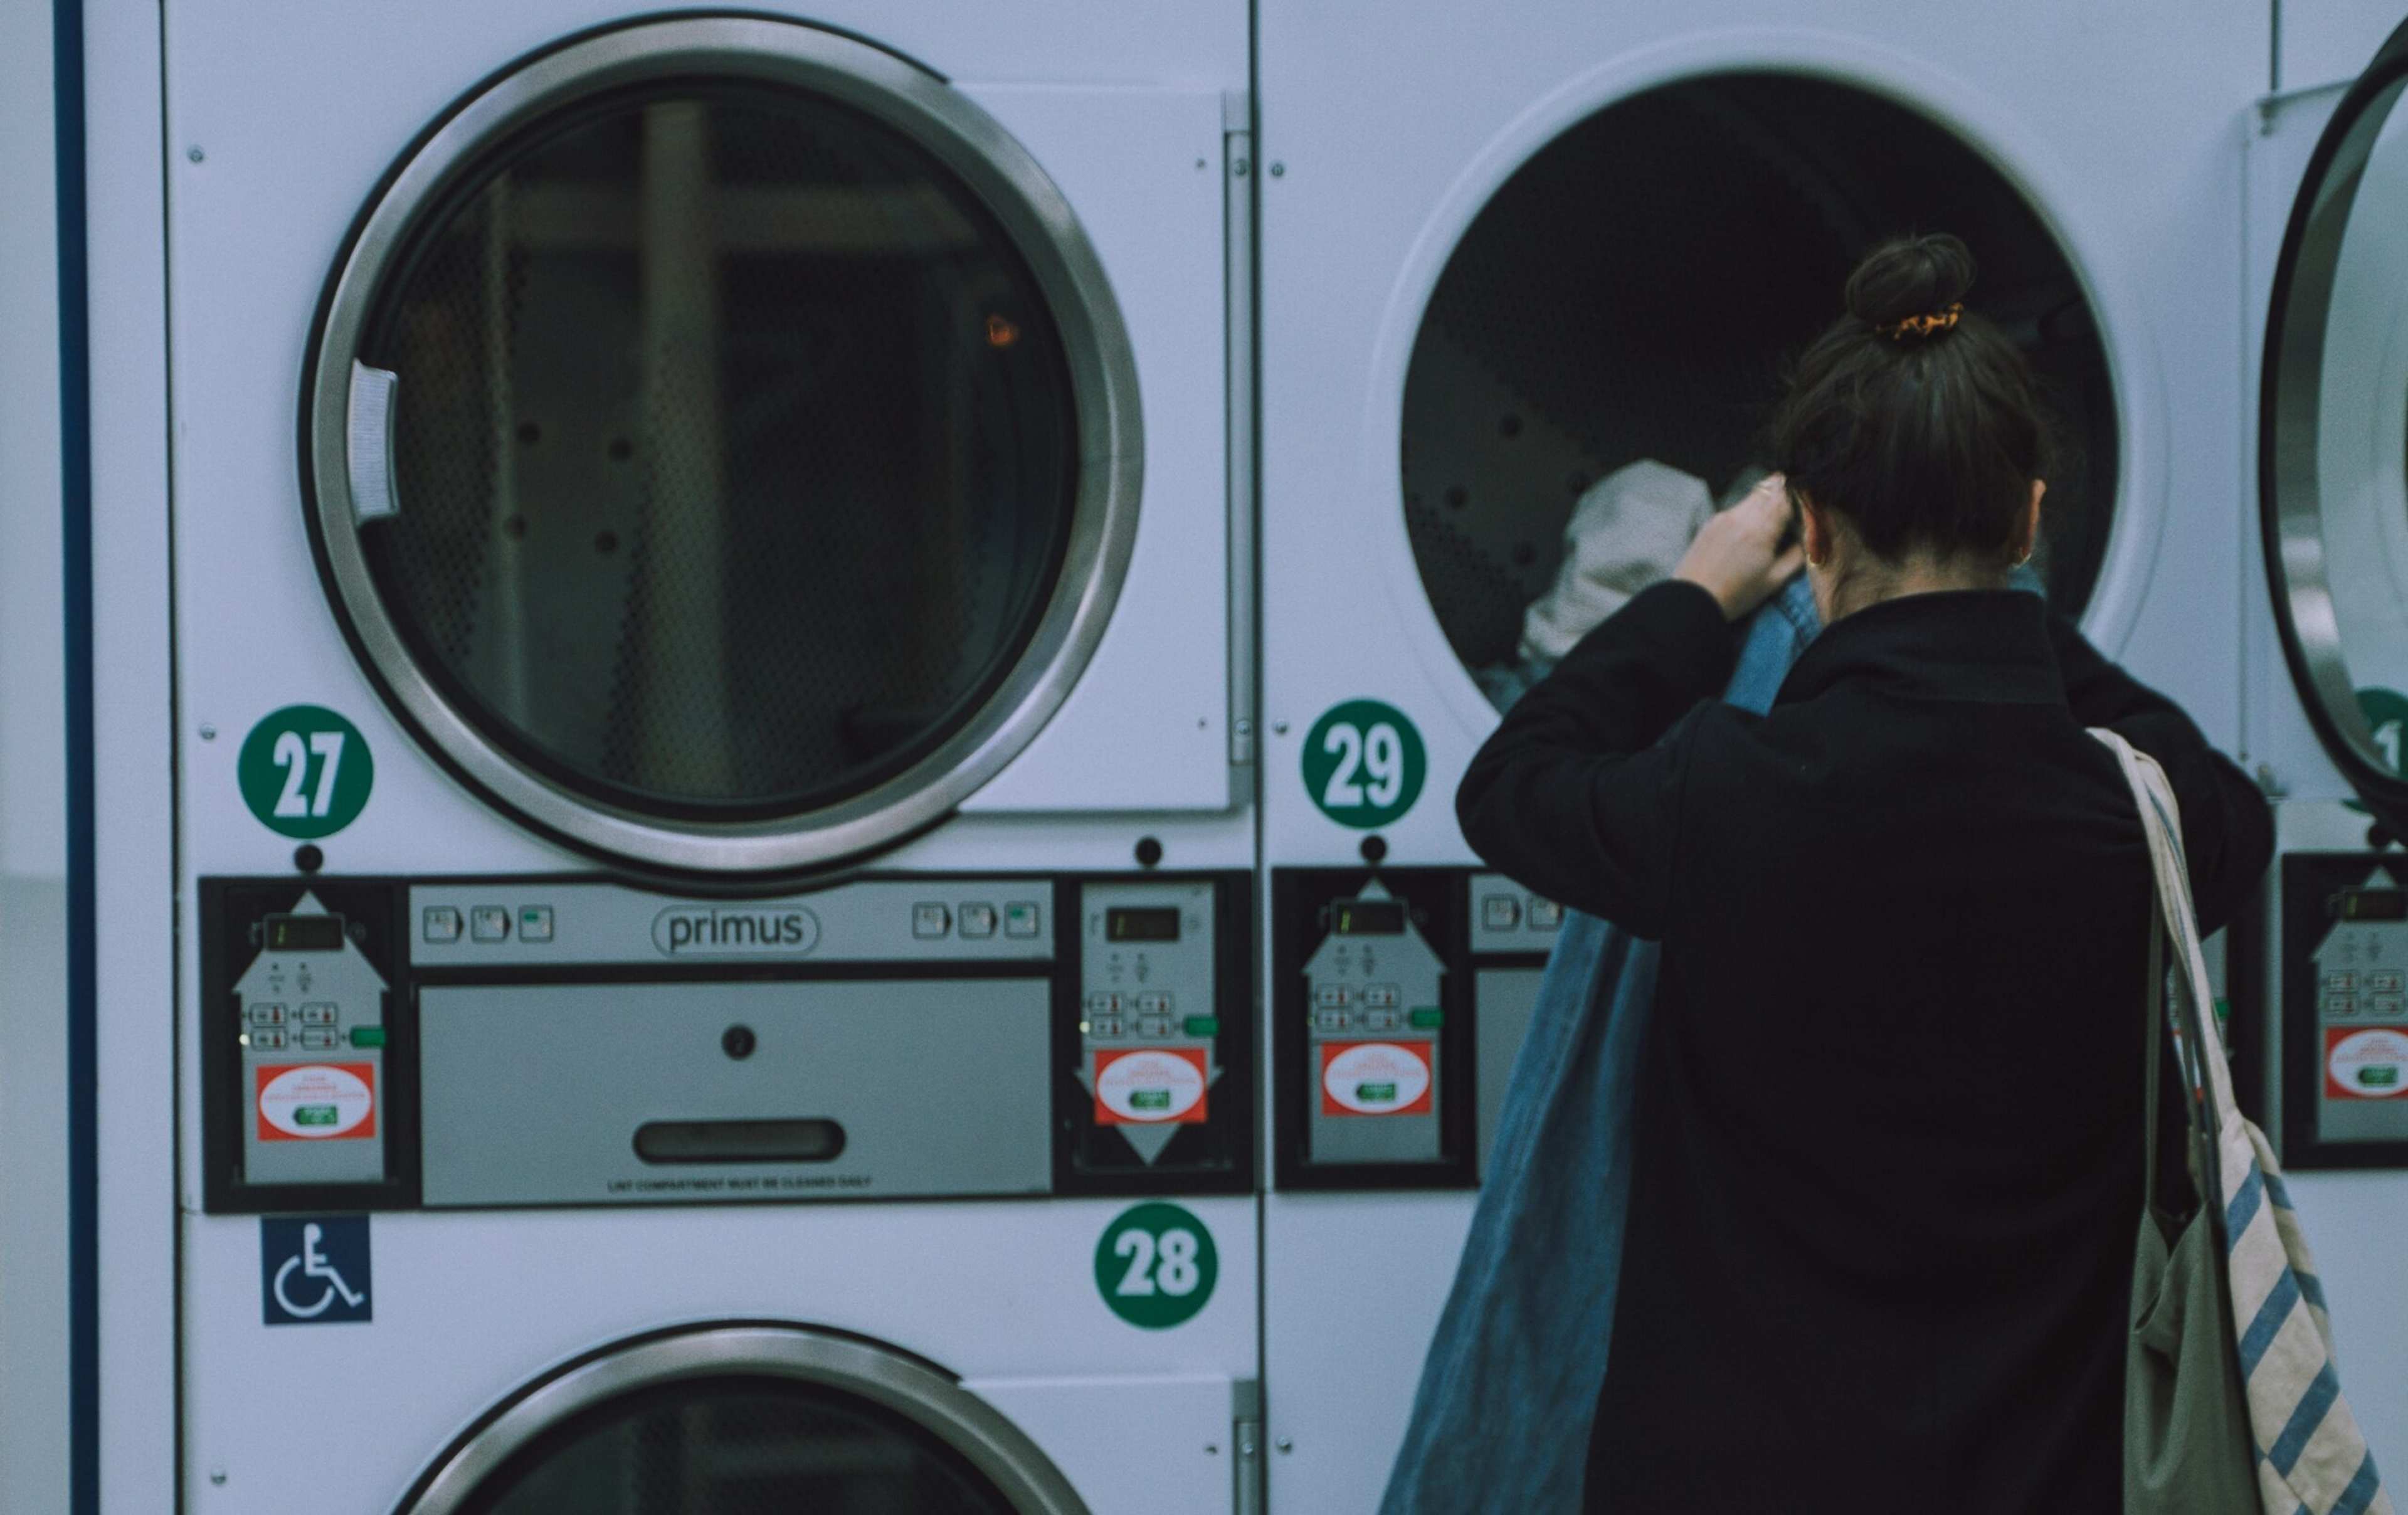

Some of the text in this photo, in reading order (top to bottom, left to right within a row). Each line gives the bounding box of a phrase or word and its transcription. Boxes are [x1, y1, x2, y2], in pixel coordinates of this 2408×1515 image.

[273, 731, 344, 817] 27
[1324, 722, 1403, 808] 29
[669, 908, 803, 953] primus
[1114, 1227, 1200, 1297] 28
